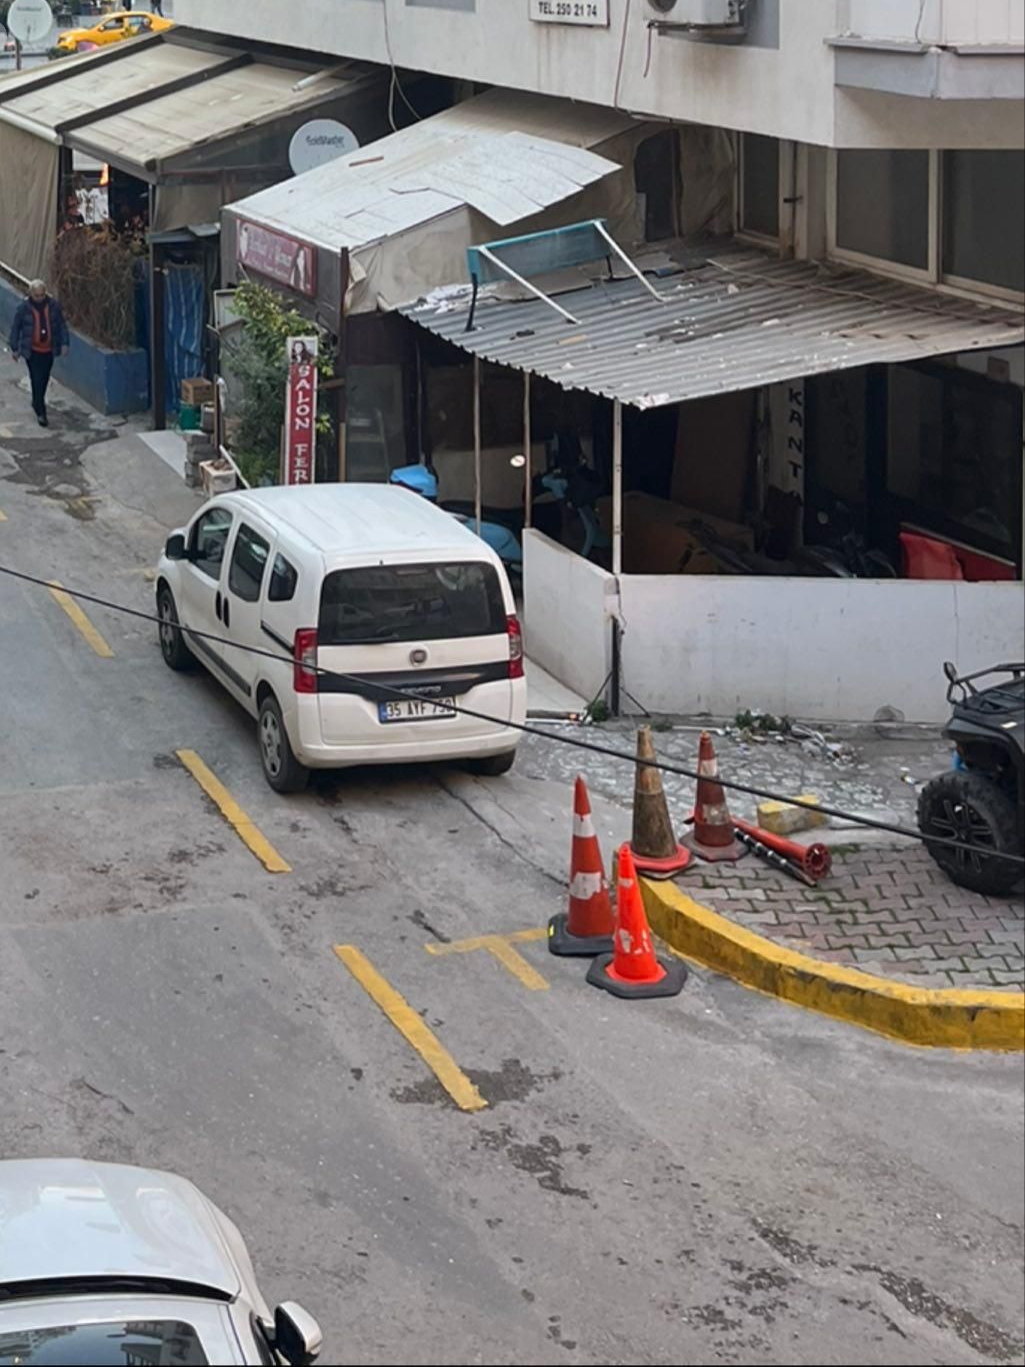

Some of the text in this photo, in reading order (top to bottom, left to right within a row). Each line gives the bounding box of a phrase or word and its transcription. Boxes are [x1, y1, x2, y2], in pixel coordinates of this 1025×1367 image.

[538, 1, 598, 17] TEL. 250 21 74
[293, 365, 311, 483] SALON FER
[386, 702, 401, 717] 35
[407, 700, 426, 715] AYF
